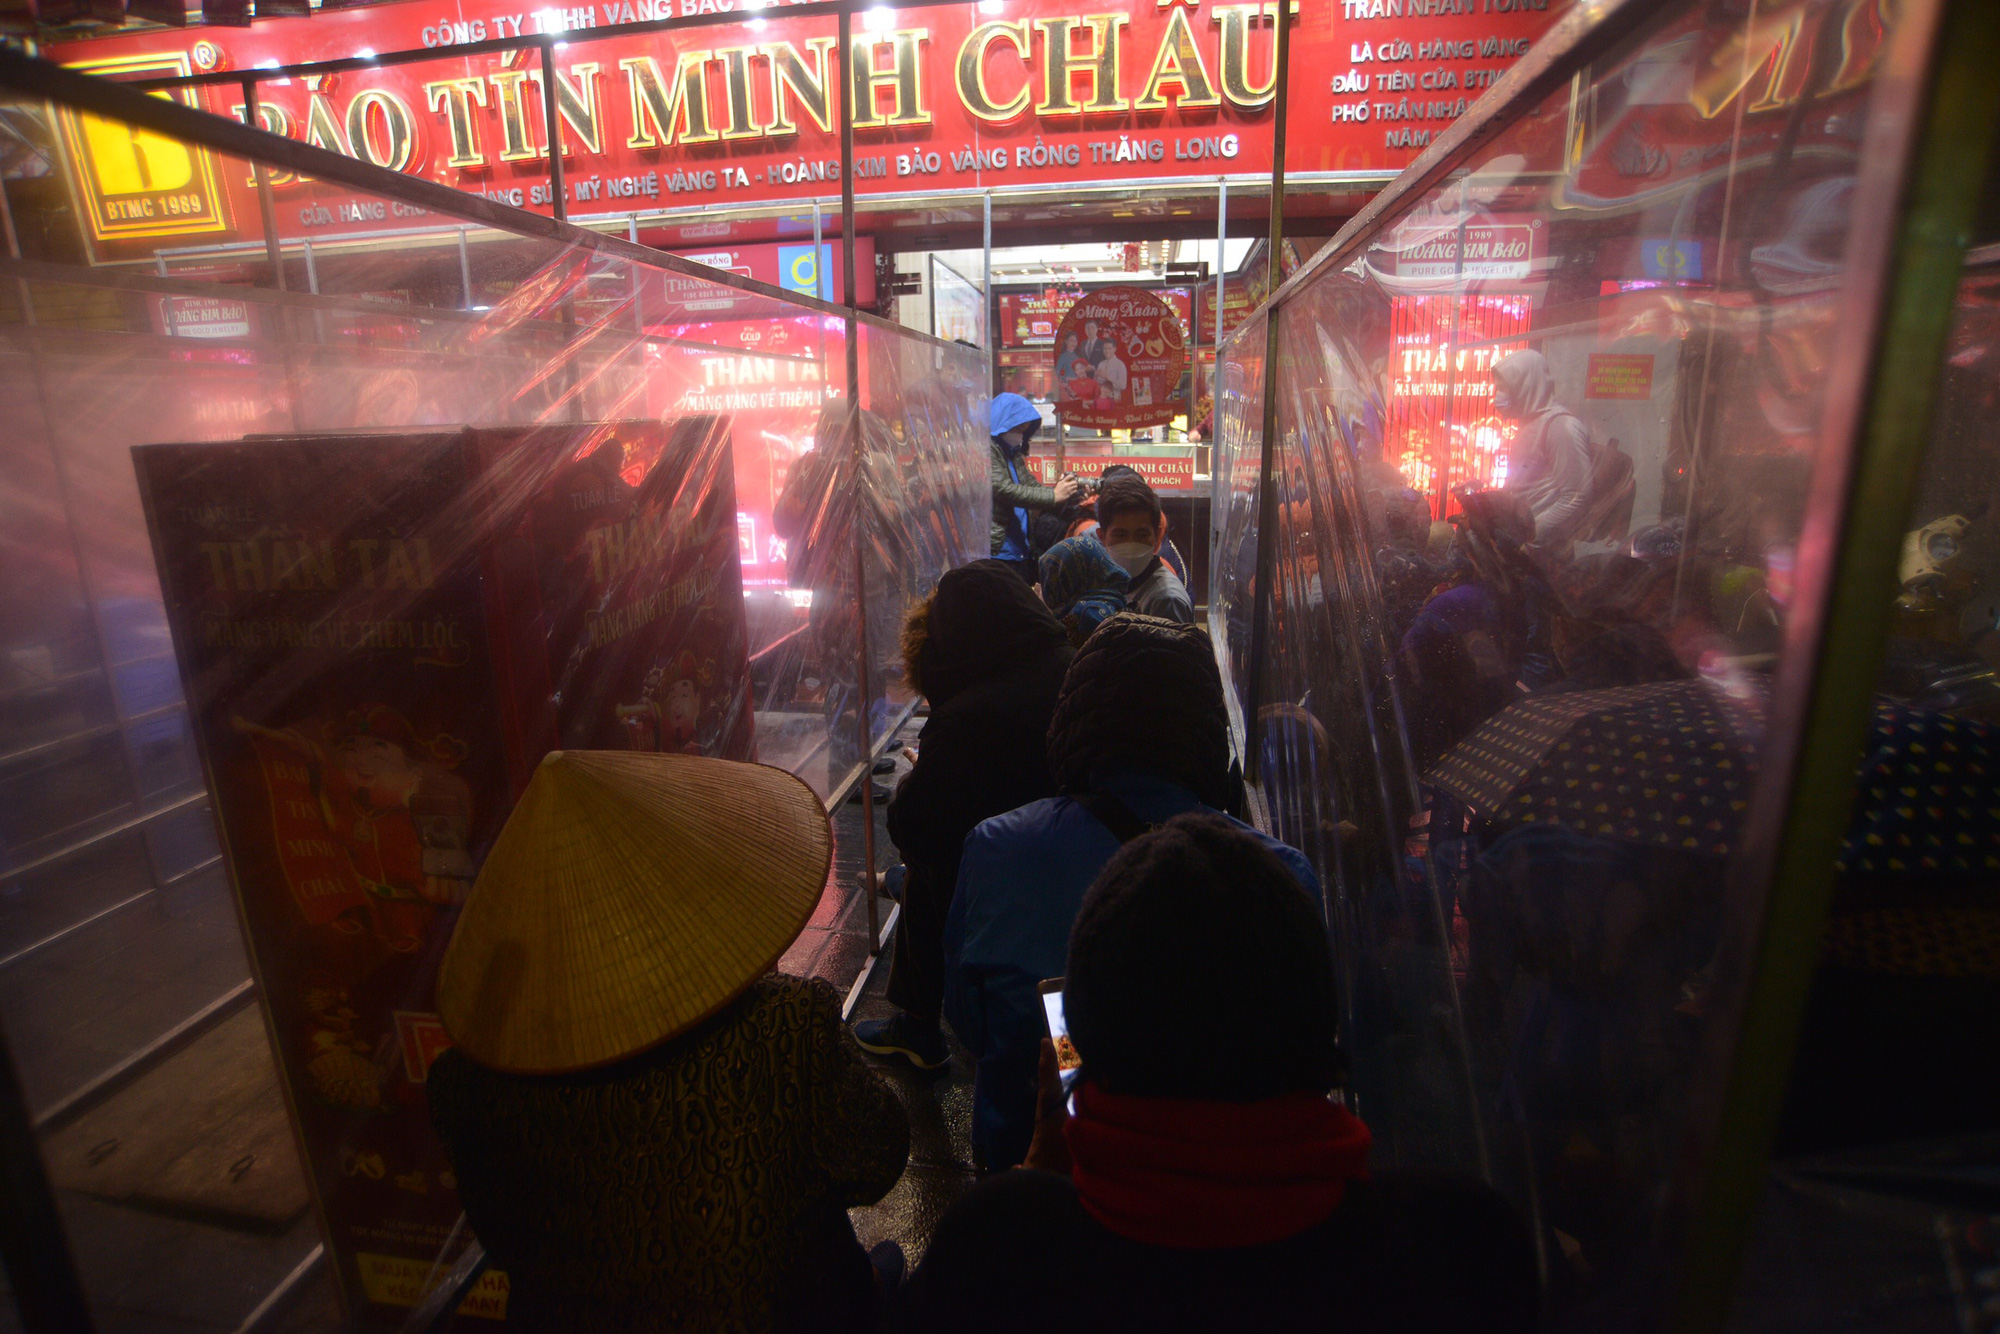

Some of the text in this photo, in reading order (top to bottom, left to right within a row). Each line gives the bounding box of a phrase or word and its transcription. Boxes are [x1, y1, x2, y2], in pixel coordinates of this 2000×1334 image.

[422, 18, 487, 48] CÔNG
[492, 14, 523, 39] TY
[1350, 36, 1530, 63] LÀ CỬA HÀNG VÀNG
[426, 50, 601, 168] TÍN
[619, 27, 933, 150] MINH
[955, 0, 1299, 121] CHÂU
[1331, 69, 1370, 93] ĐẦU
[1376, 70, 1415, 92] TIÊN
[1420, 66, 1458, 90] CỦA
[1331, 99, 1370, 122] PHỐ
[1373, 97, 1424, 121] TRẦN
[1386, 129, 1431, 148] NĂM
[339, 198, 385, 223] HÀNG
[575, 174, 601, 201] MỸ
[607, 171, 659, 199] NGHỆ
[664, 167, 716, 193] VÀNG
[721, 166, 750, 188] TA
[767, 156, 840, 185] HOÀNG
[852, 156, 886, 178] KIM
[896, 147, 942, 176] BẢO
[950, 143, 1008, 171] VÀNG
[1016, 135, 1080, 168] RỒNG
[1088, 135, 1164, 162] THĂNG
[1175, 133, 1239, 160] LONG
[106, 194, 202, 220] BTMC 1989
[1469, 231, 1492, 240] 1989
[1401, 238, 1526, 260] HOÀNG KIM BẢO
[1411, 266, 1437, 275] PURE
[201, 307, 221, 322] KIM
[1072, 459, 1098, 473] BẢO
[1158, 461, 1193, 474] CHÂU
[349, 525, 437, 591] TÀI
